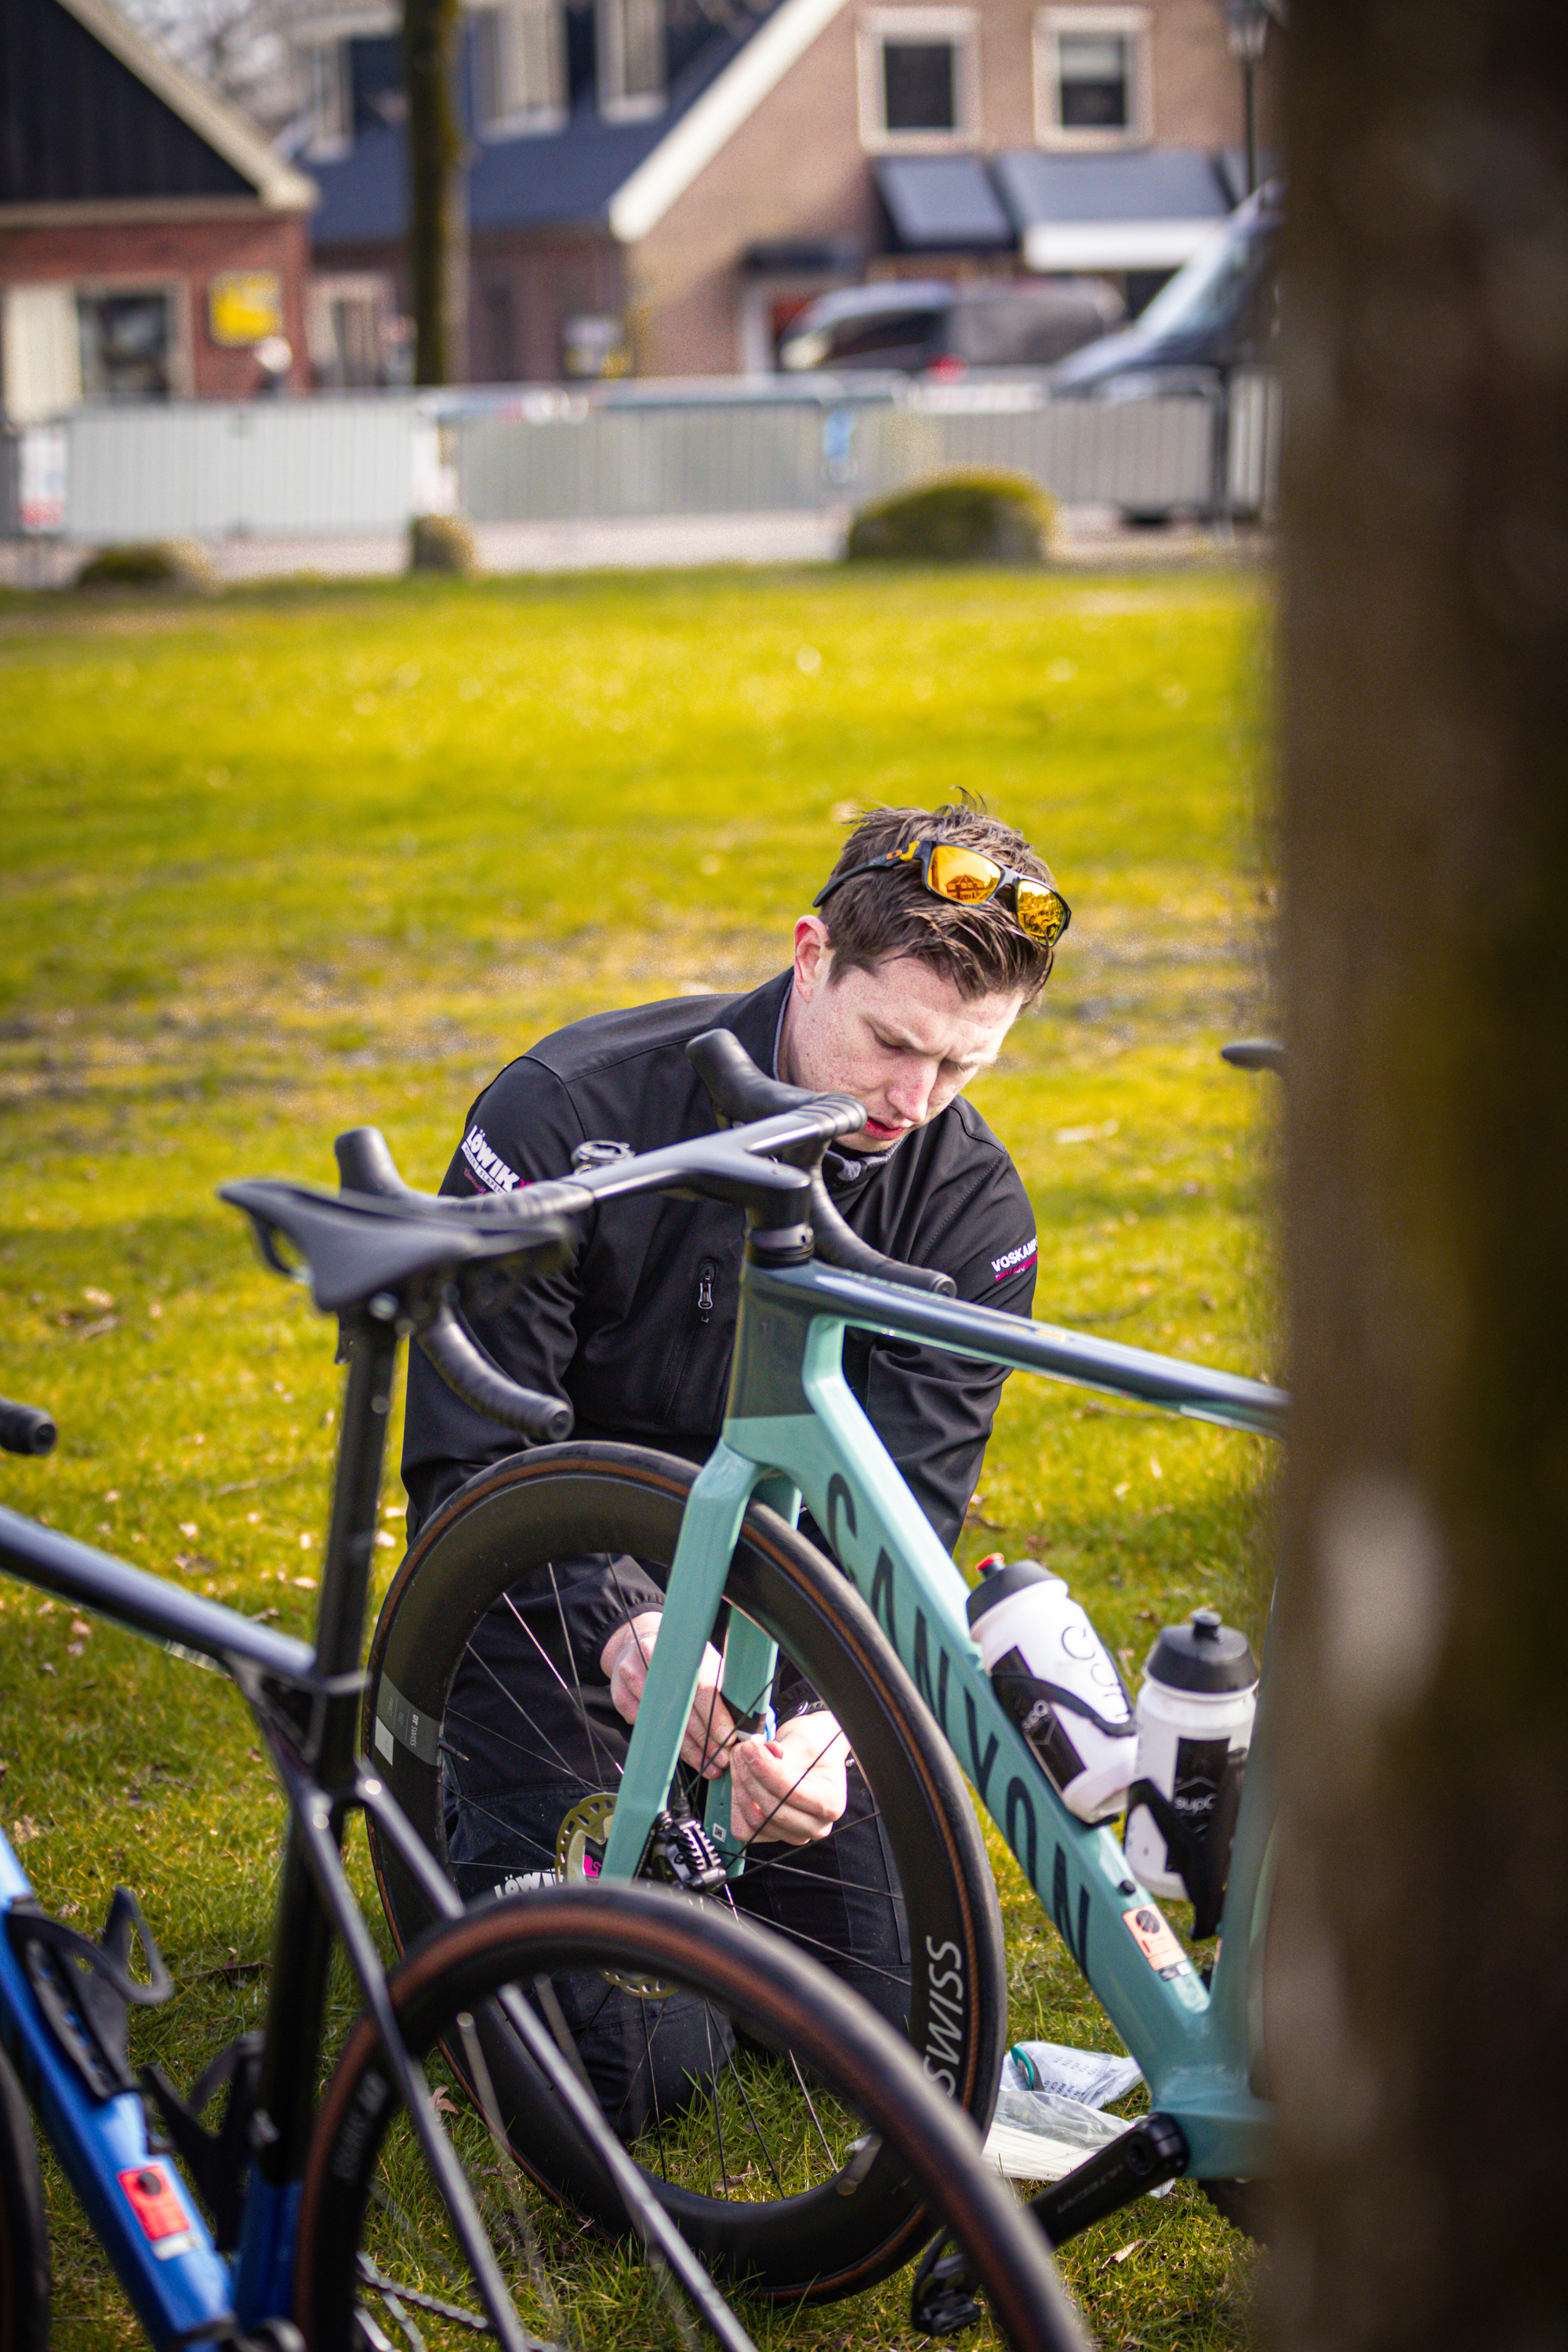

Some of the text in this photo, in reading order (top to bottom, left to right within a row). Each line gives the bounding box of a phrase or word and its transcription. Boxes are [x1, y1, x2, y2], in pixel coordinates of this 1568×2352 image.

[466, 1124, 521, 1193] LÖWIK
[412, 1713, 419, 1726] DT
[827, 1472, 1091, 1981] CANYON
[923, 1935, 964, 2098] SWISS
